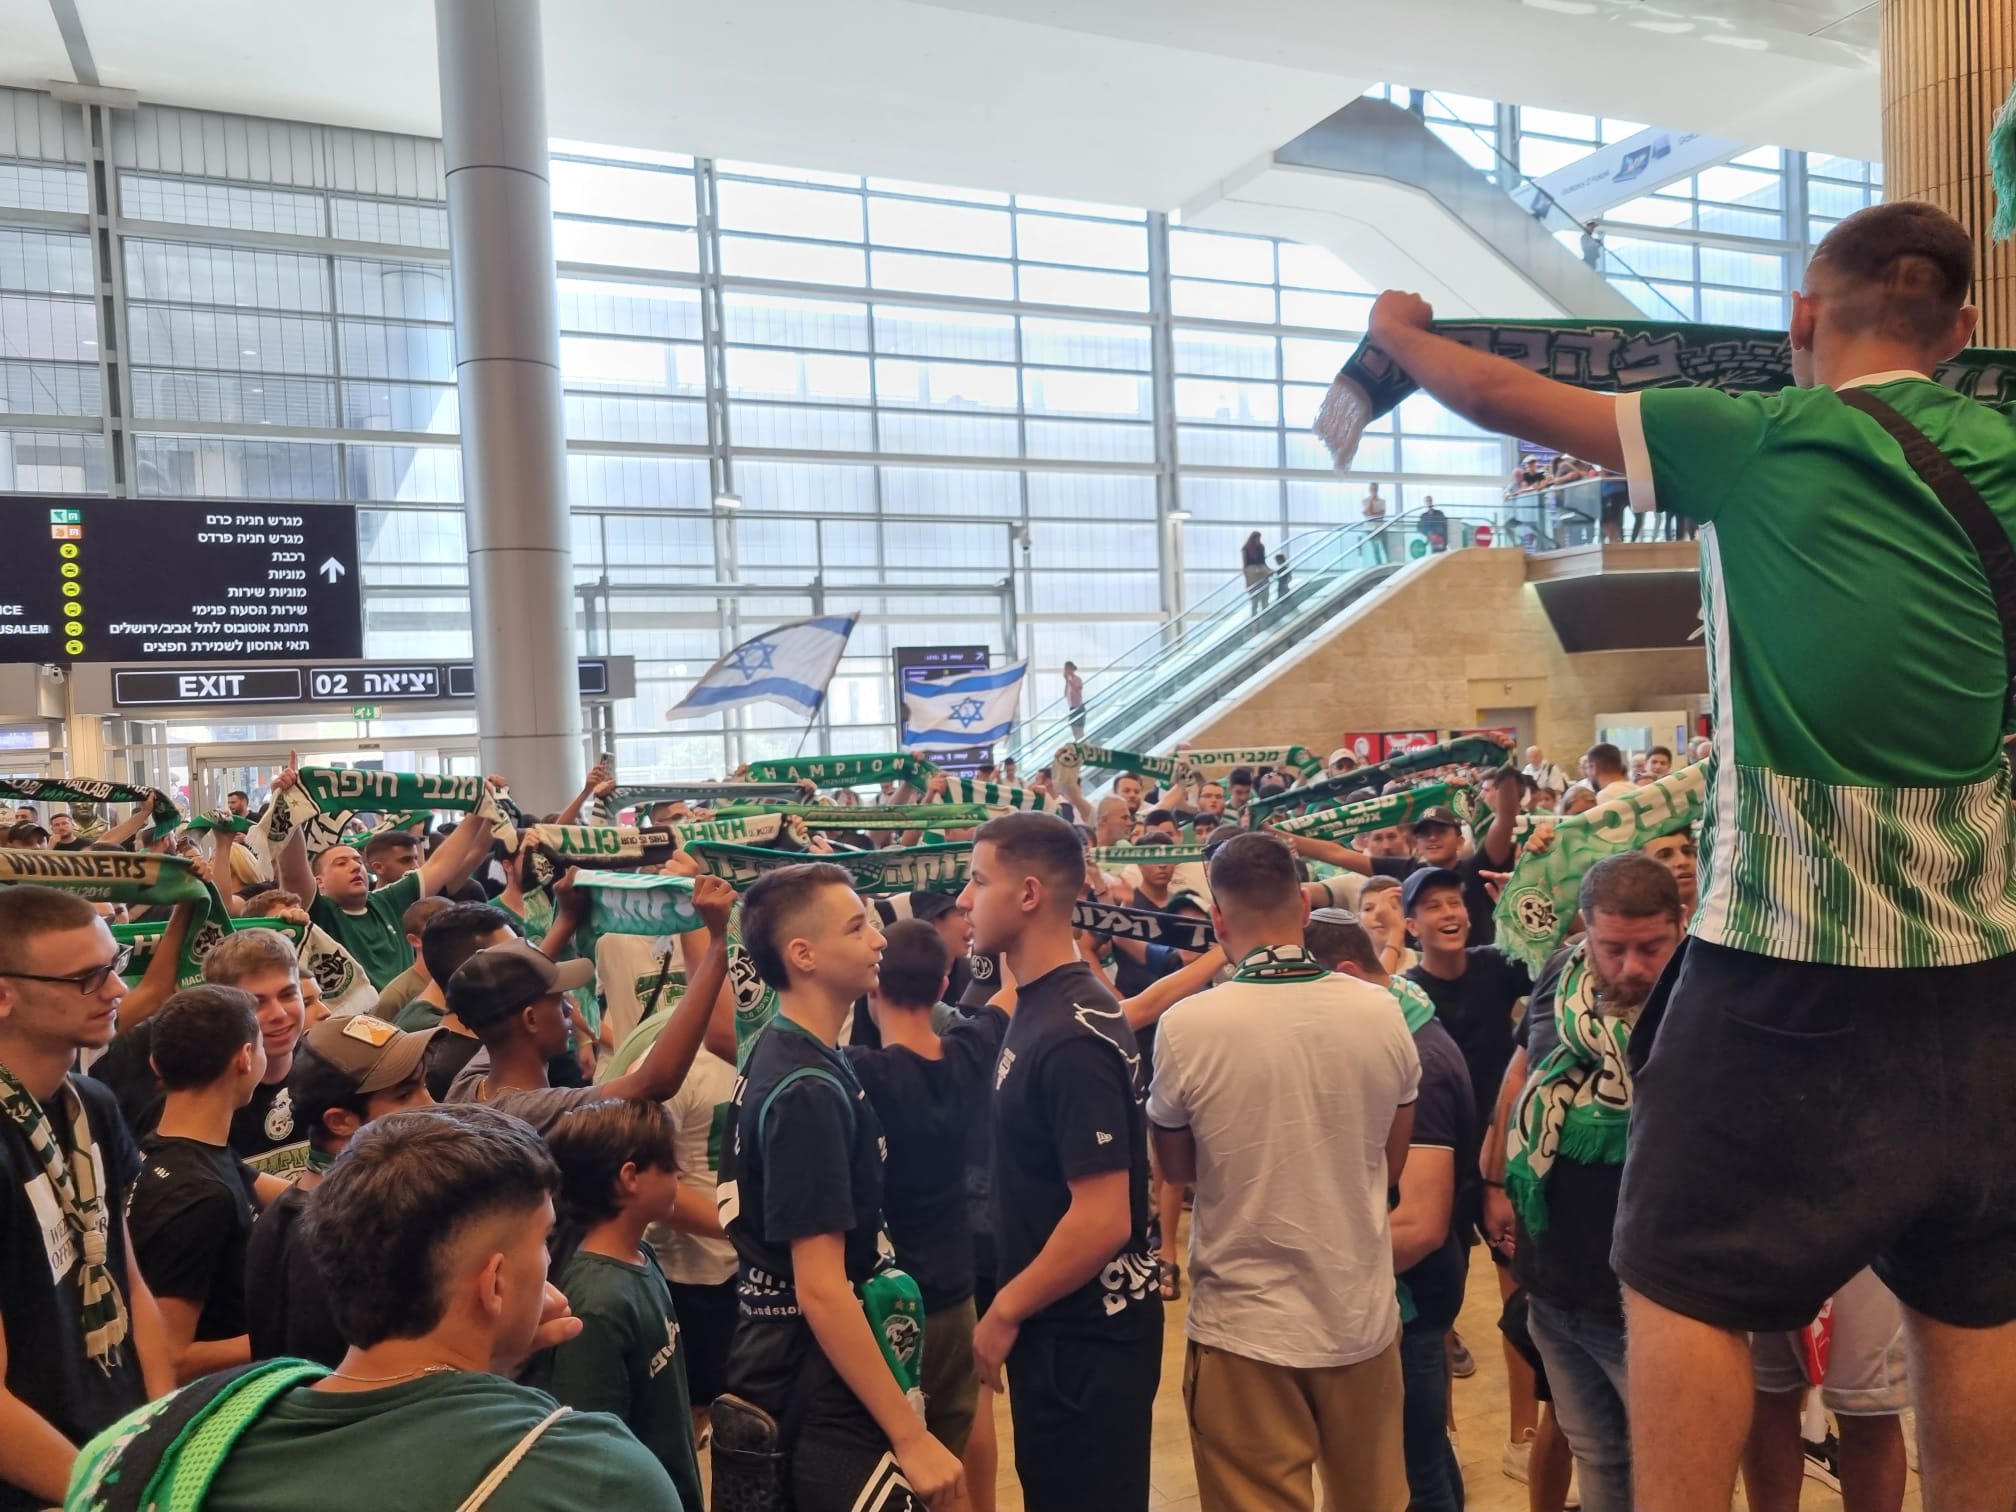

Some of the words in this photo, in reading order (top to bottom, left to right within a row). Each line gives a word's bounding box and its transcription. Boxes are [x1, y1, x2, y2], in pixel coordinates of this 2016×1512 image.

[205, 514, 233, 525] כרם
[235, 515, 265, 526] חניה
[267, 515, 304, 527] מגרש
[197, 532, 234, 543] פרדס
[236, 533, 265, 544] חניה
[268, 533, 304, 545] מגרש
[271, 551, 306, 562] רכבת
[267, 569, 306, 580] מוניות
[227, 586, 266, 598] שירות
[269, 587, 307, 598] מוניות
[192, 604, 227, 616] פנימי
[230, 605, 268, 617] הסעה
[271, 605, 308, 616] שירות
[194, 620, 221, 634] לתל
[223, 622, 271, 634] אוטובוס
[273, 622, 309, 634] תחנת
[143, 641, 187, 653] חפצים
[190, 639, 244, 653] לשמירת
[246, 640, 283, 654] אחסון
[286, 640, 310, 651] תאי
[179, 675, 246, 697] EXIT
[315, 674, 349, 695] 02
[363, 672, 434, 693] יציאה
[1188, 752, 1235, 765] חיפה
[1241, 751, 1280, 763] מכבי
[746, 758, 922, 783] CHAMPIONS
[57, 779, 114, 800] MACCABI
[313, 769, 399, 799] חיפה
[416, 773, 479, 801] מכבי
[558, 825, 621, 854] CITY
[7, 853, 147, 879] WINNERS
